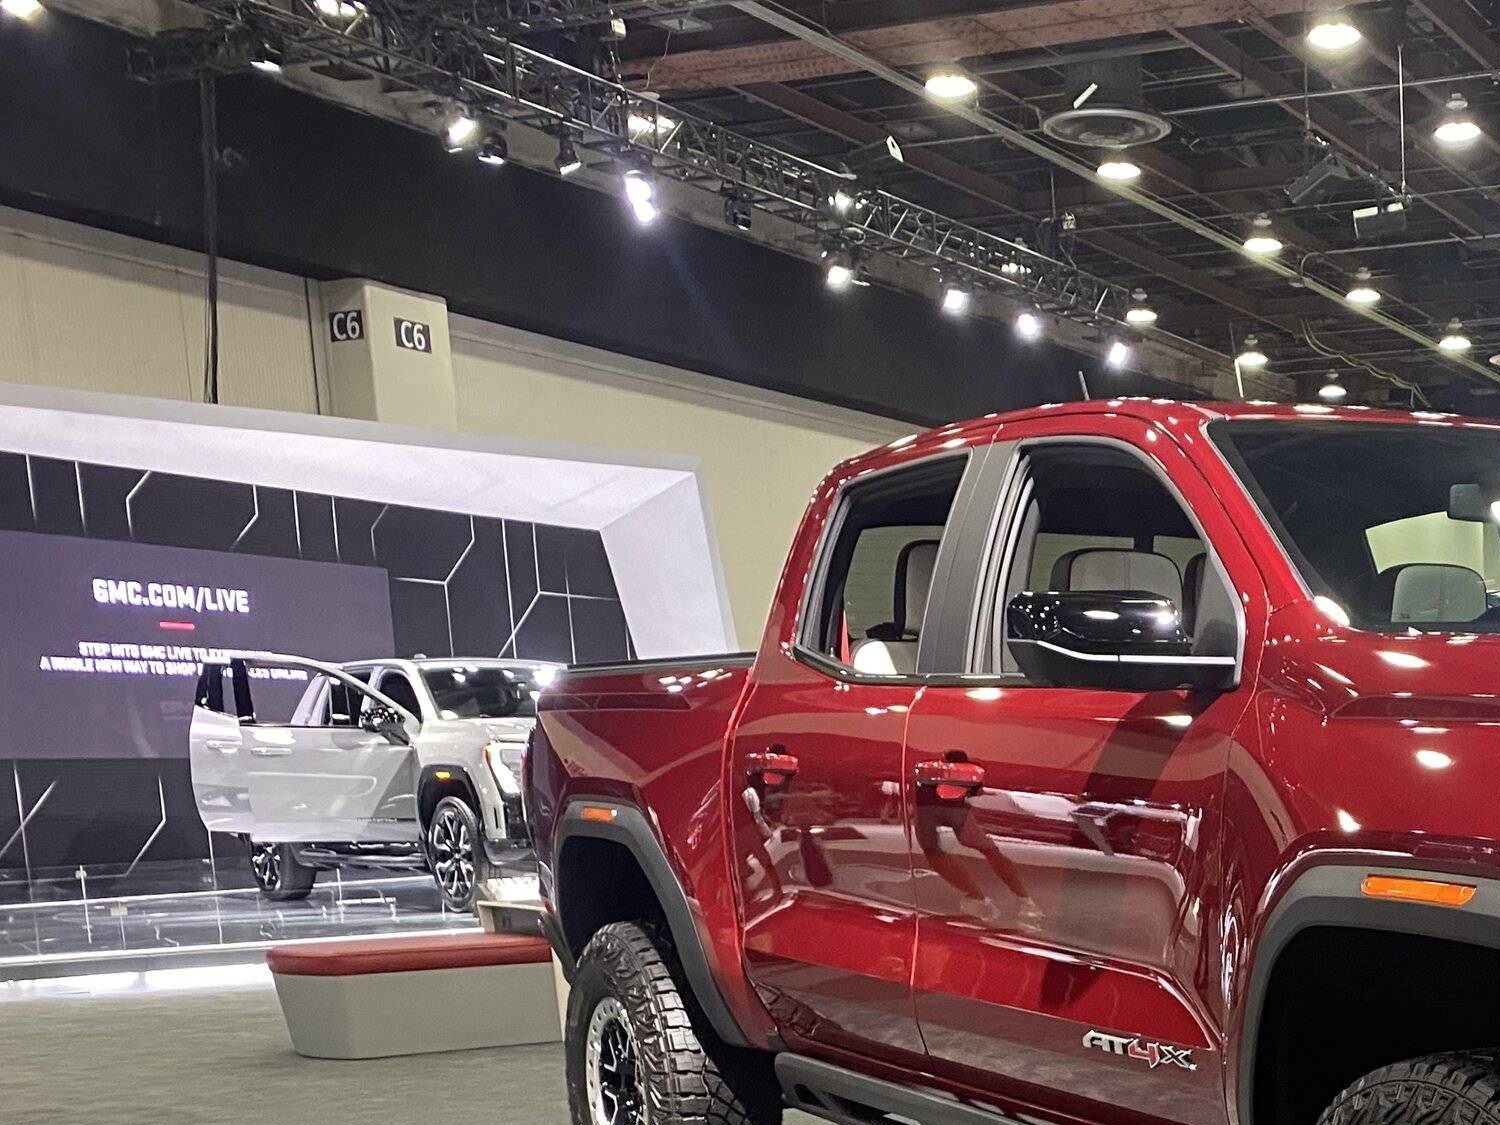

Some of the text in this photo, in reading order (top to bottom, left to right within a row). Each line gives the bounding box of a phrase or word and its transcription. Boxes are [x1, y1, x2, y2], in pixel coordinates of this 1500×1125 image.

[332, 311, 361, 341] C6
[400, 320, 426, 351] C6
[92, 578, 250, 614] GMC.COM/LIVE
[40, 655, 51, 671] A
[50, 656, 95, 673] WHOLE
[122, 660, 148, 675] WAY
[149, 661, 164, 675] TO
[79, 641, 110, 657] STEP
[167, 645, 193, 661] LIVE
[1082, 1029, 1198, 1071] AT4X
